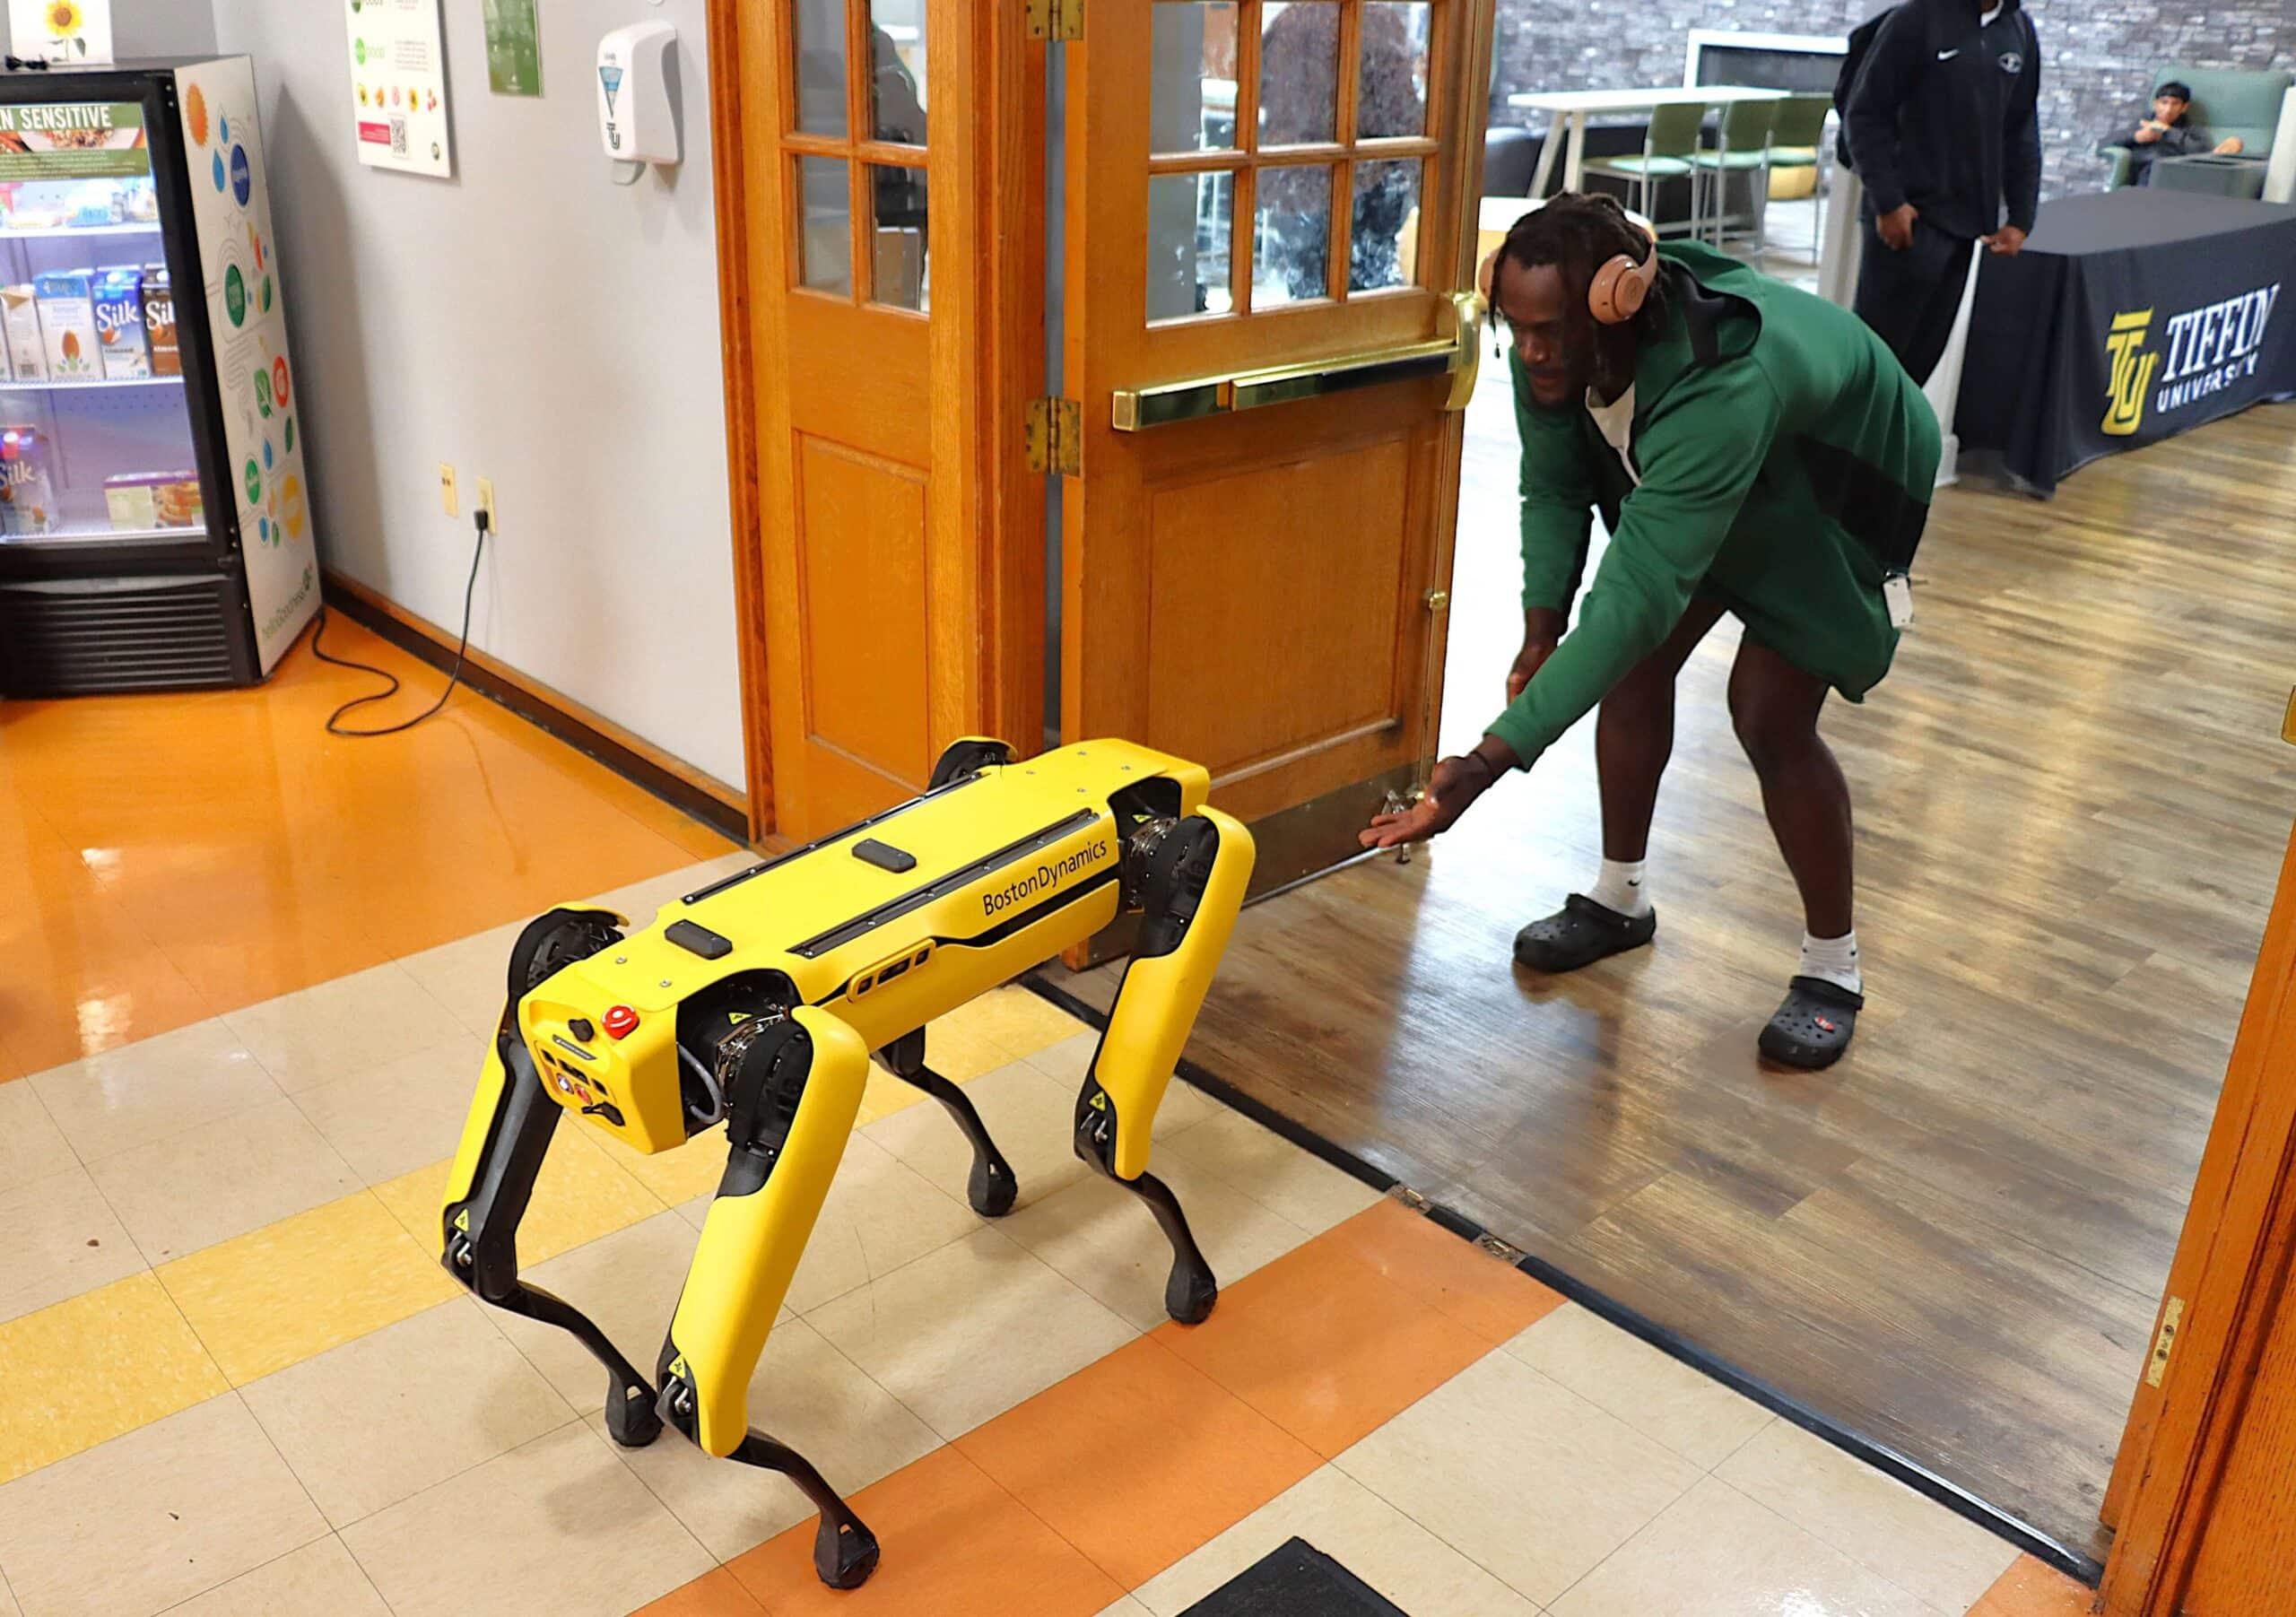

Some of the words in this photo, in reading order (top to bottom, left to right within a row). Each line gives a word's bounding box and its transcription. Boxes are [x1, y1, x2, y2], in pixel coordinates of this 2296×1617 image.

[0, 108, 14, 130] N
[20, 105, 112, 130] SENSITIVE
[96, 300, 140, 333] Silk
[145, 300, 176, 330] Sil
[2161, 282, 2281, 382] TIFFIN
[2156, 351, 2259, 413] UNIVERSY
